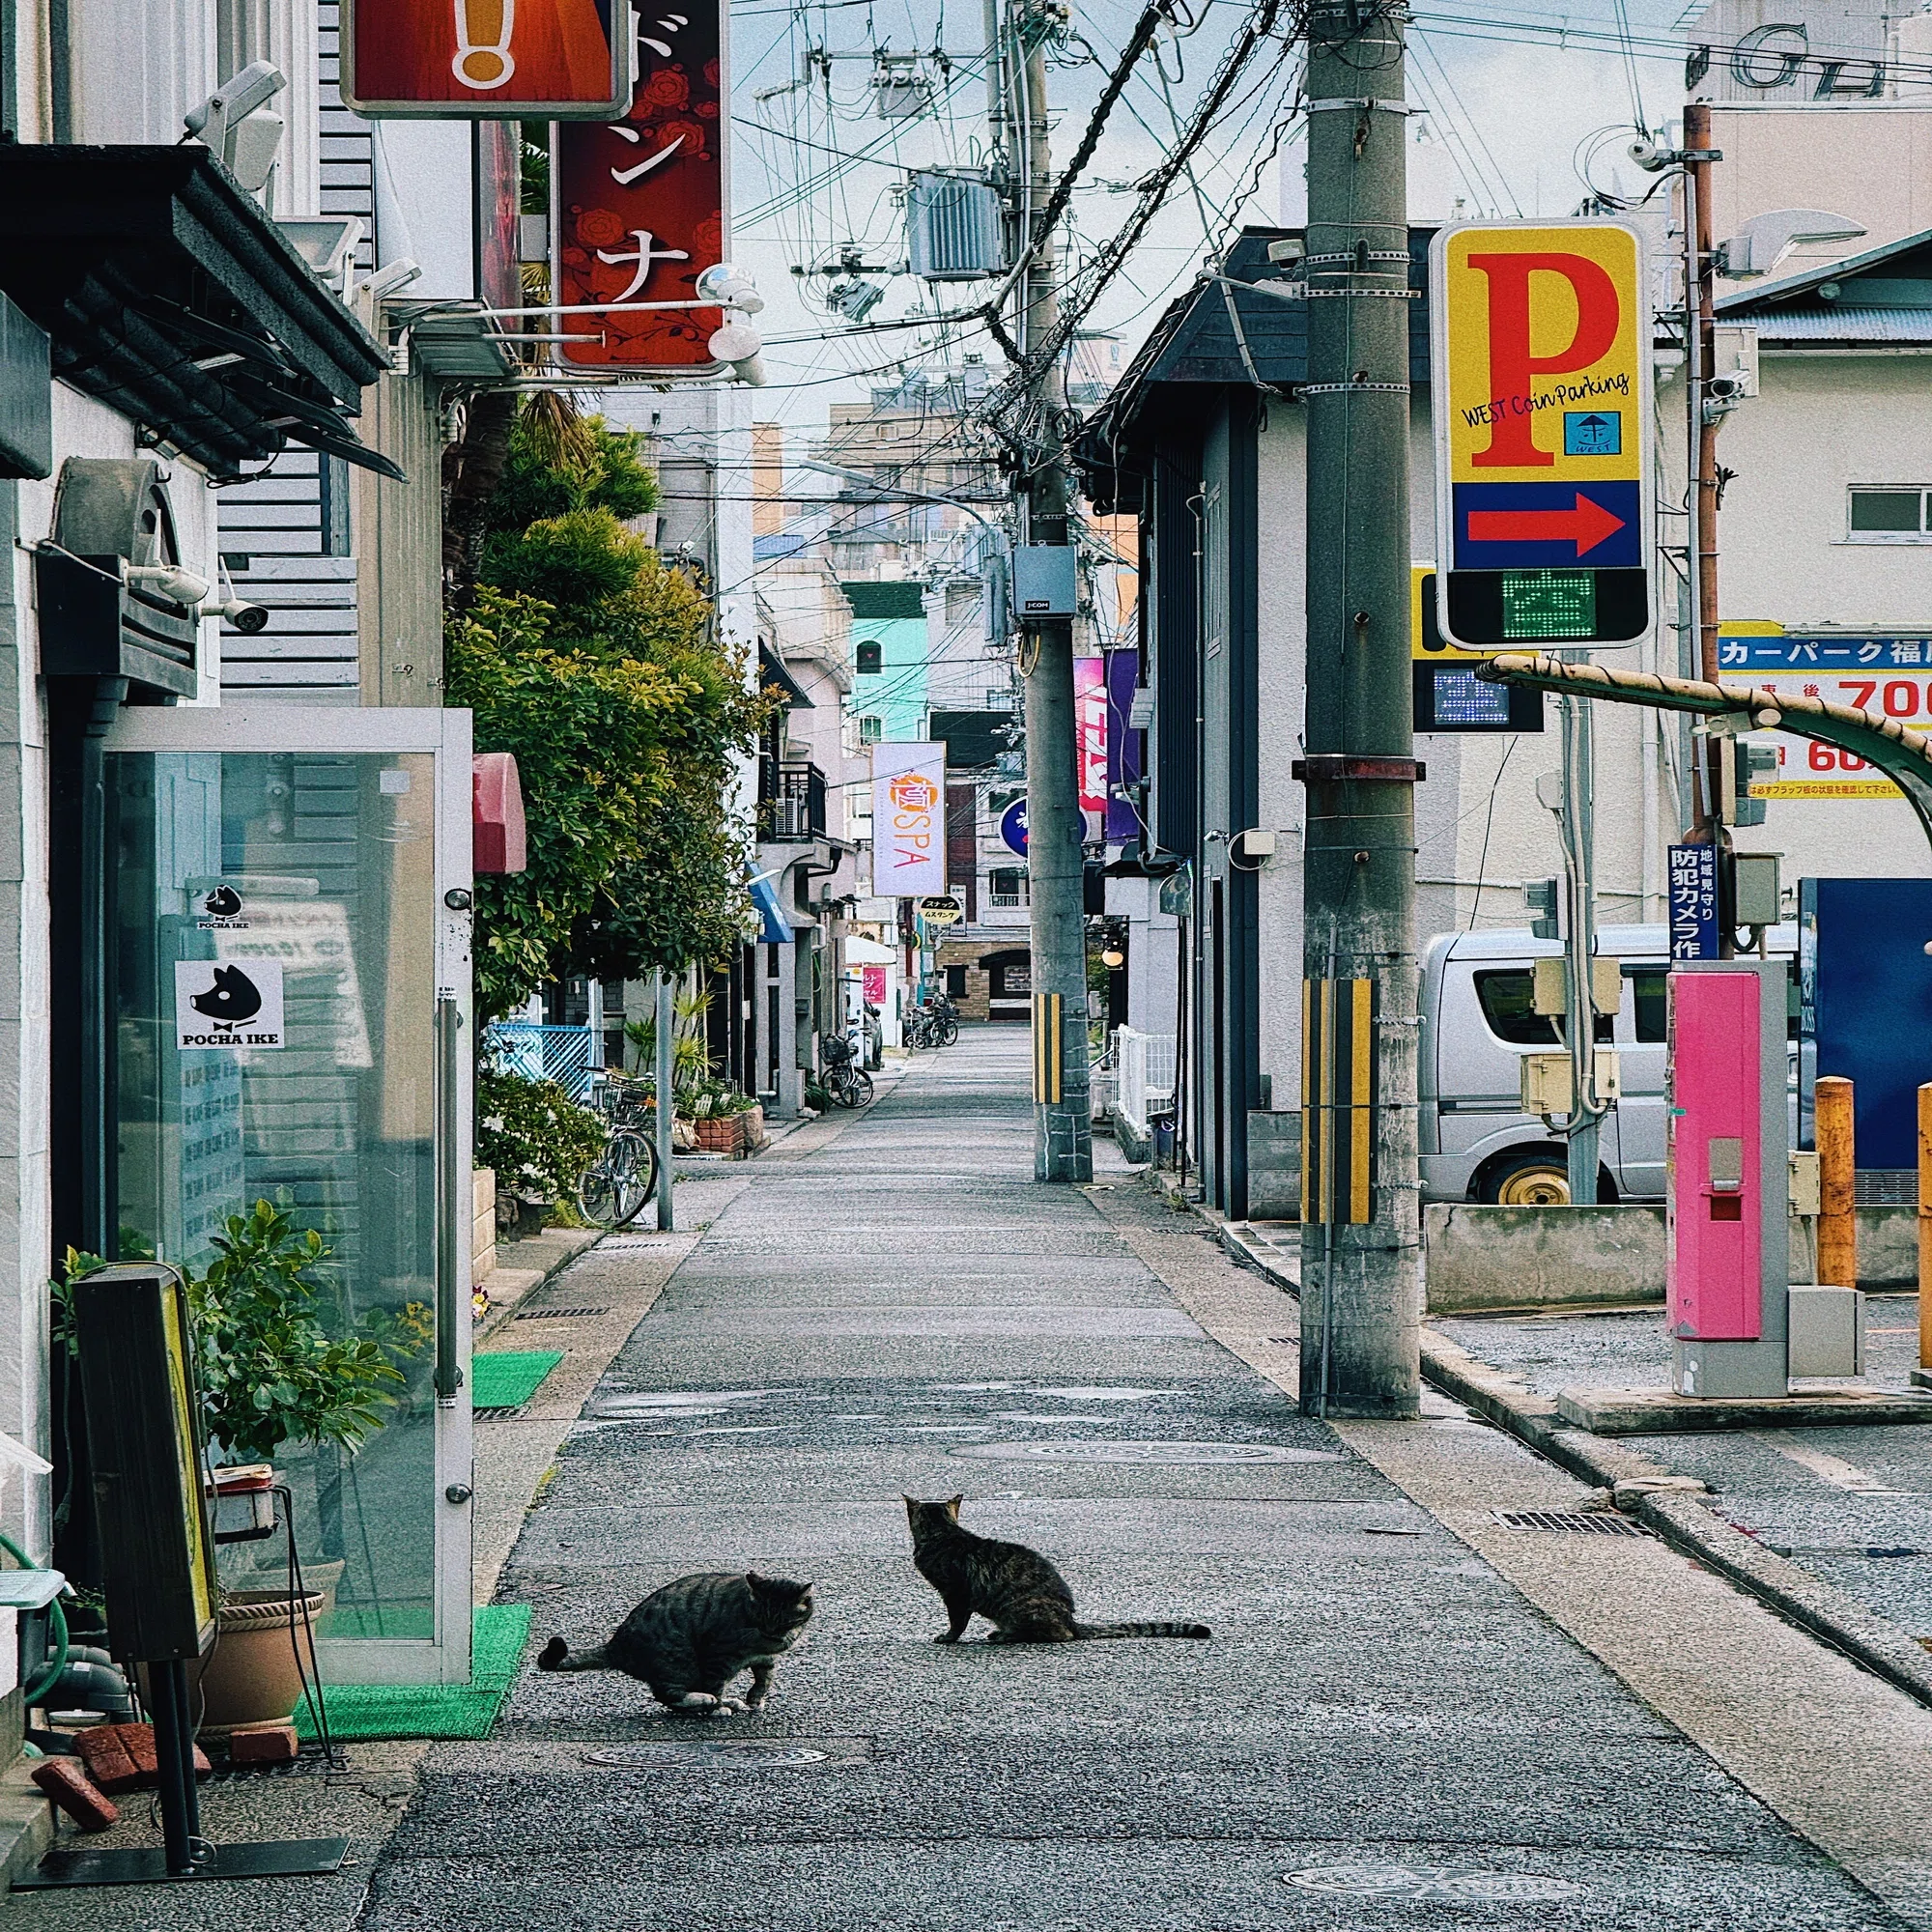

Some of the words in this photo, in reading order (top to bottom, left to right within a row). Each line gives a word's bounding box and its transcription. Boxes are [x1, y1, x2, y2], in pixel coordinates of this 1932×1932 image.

[1466, 252, 1620, 467] P
[1461, 398, 1506, 428] WEST
[1511, 392, 1556, 415] Coin
[1554, 372, 1631, 406] Parking
[1575, 443, 1612, 454] WEST
[1837, 680, 1932, 718] 70
[926, 900, 955, 909] スナック
[1671, 850, 1701, 958] 防犯カメラ作
[1700, 849, 1714, 921] 地域見守り
[183, 1035, 243, 1045] POCHA
[246, 1034, 279, 1044] IKE
